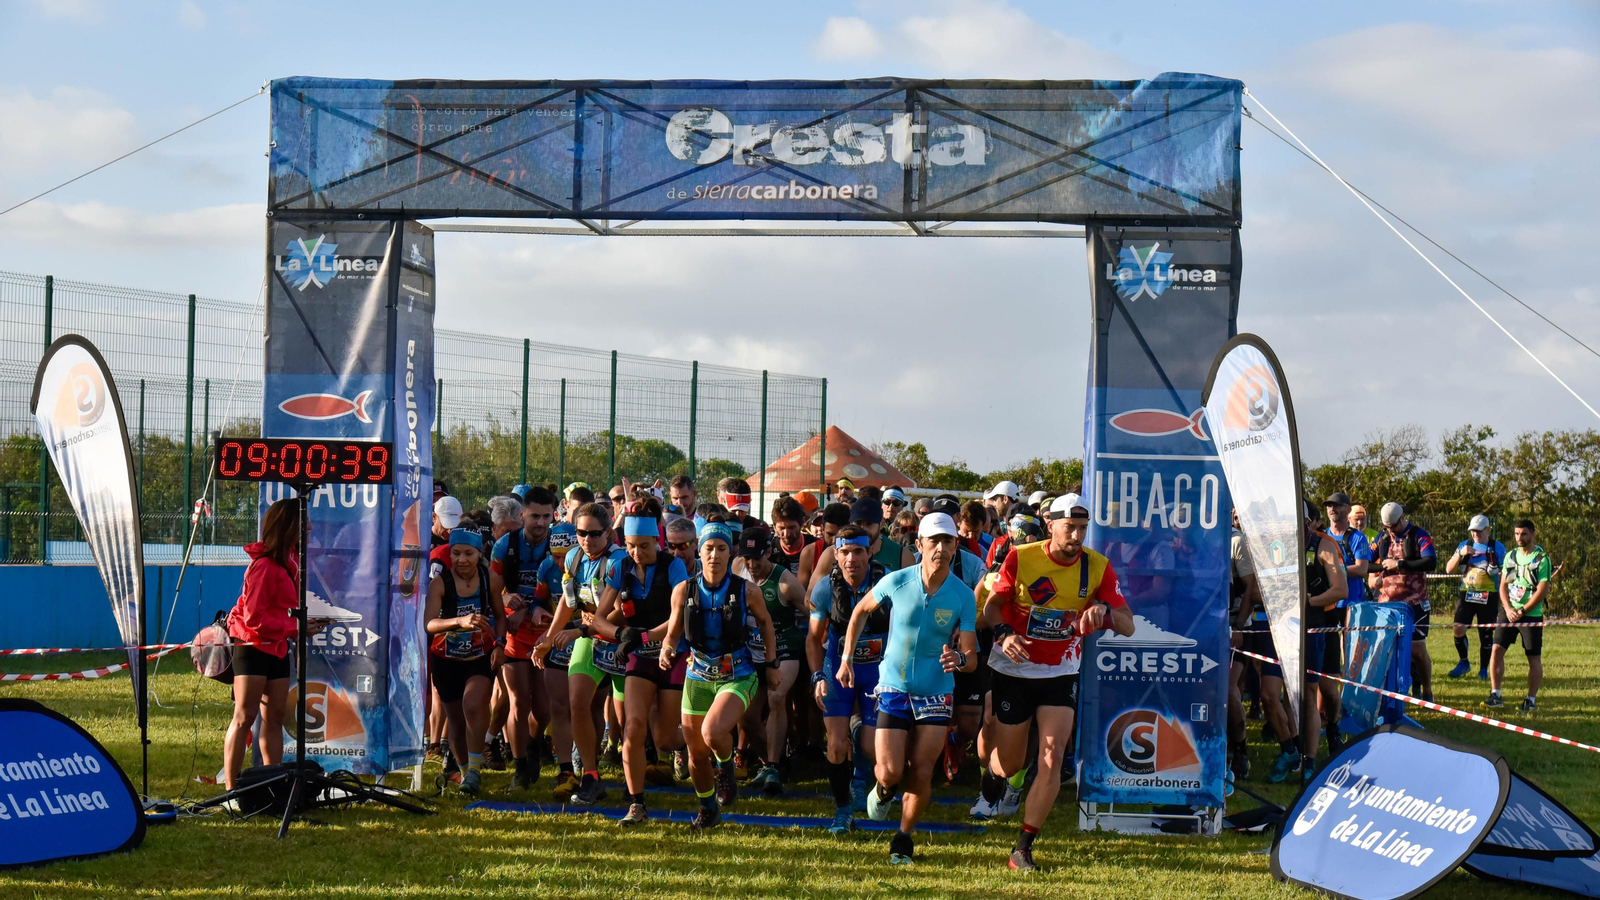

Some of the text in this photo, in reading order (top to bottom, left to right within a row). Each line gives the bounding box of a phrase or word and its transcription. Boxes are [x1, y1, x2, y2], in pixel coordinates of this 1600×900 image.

[411, 104, 427, 115] No
[436, 106, 477, 115] corro
[486, 107, 518, 119] para
[412, 124, 493, 135] corro para
[665, 107, 988, 166] Cresta
[667, 189, 687, 200] de
[274, 254, 378, 272] La Línea
[1106, 263, 1217, 283] La Línea
[219, 442, 388, 480] 09:00:39
[1094, 470, 1219, 530] UBAGO
[1045, 618, 1061, 629] 50
[458, 641, 472, 650] 25
[704, 664, 719, 674] 78
[922, 694, 946, 706] 116
[1105, 776, 1201, 789] sierracarbonera
[7, 793, 45, 819] La
[39, 787, 110, 815] Línea
[1343, 774, 1478, 835] Ayuntamiento
[1329, 814, 1435, 868] de La Línea
